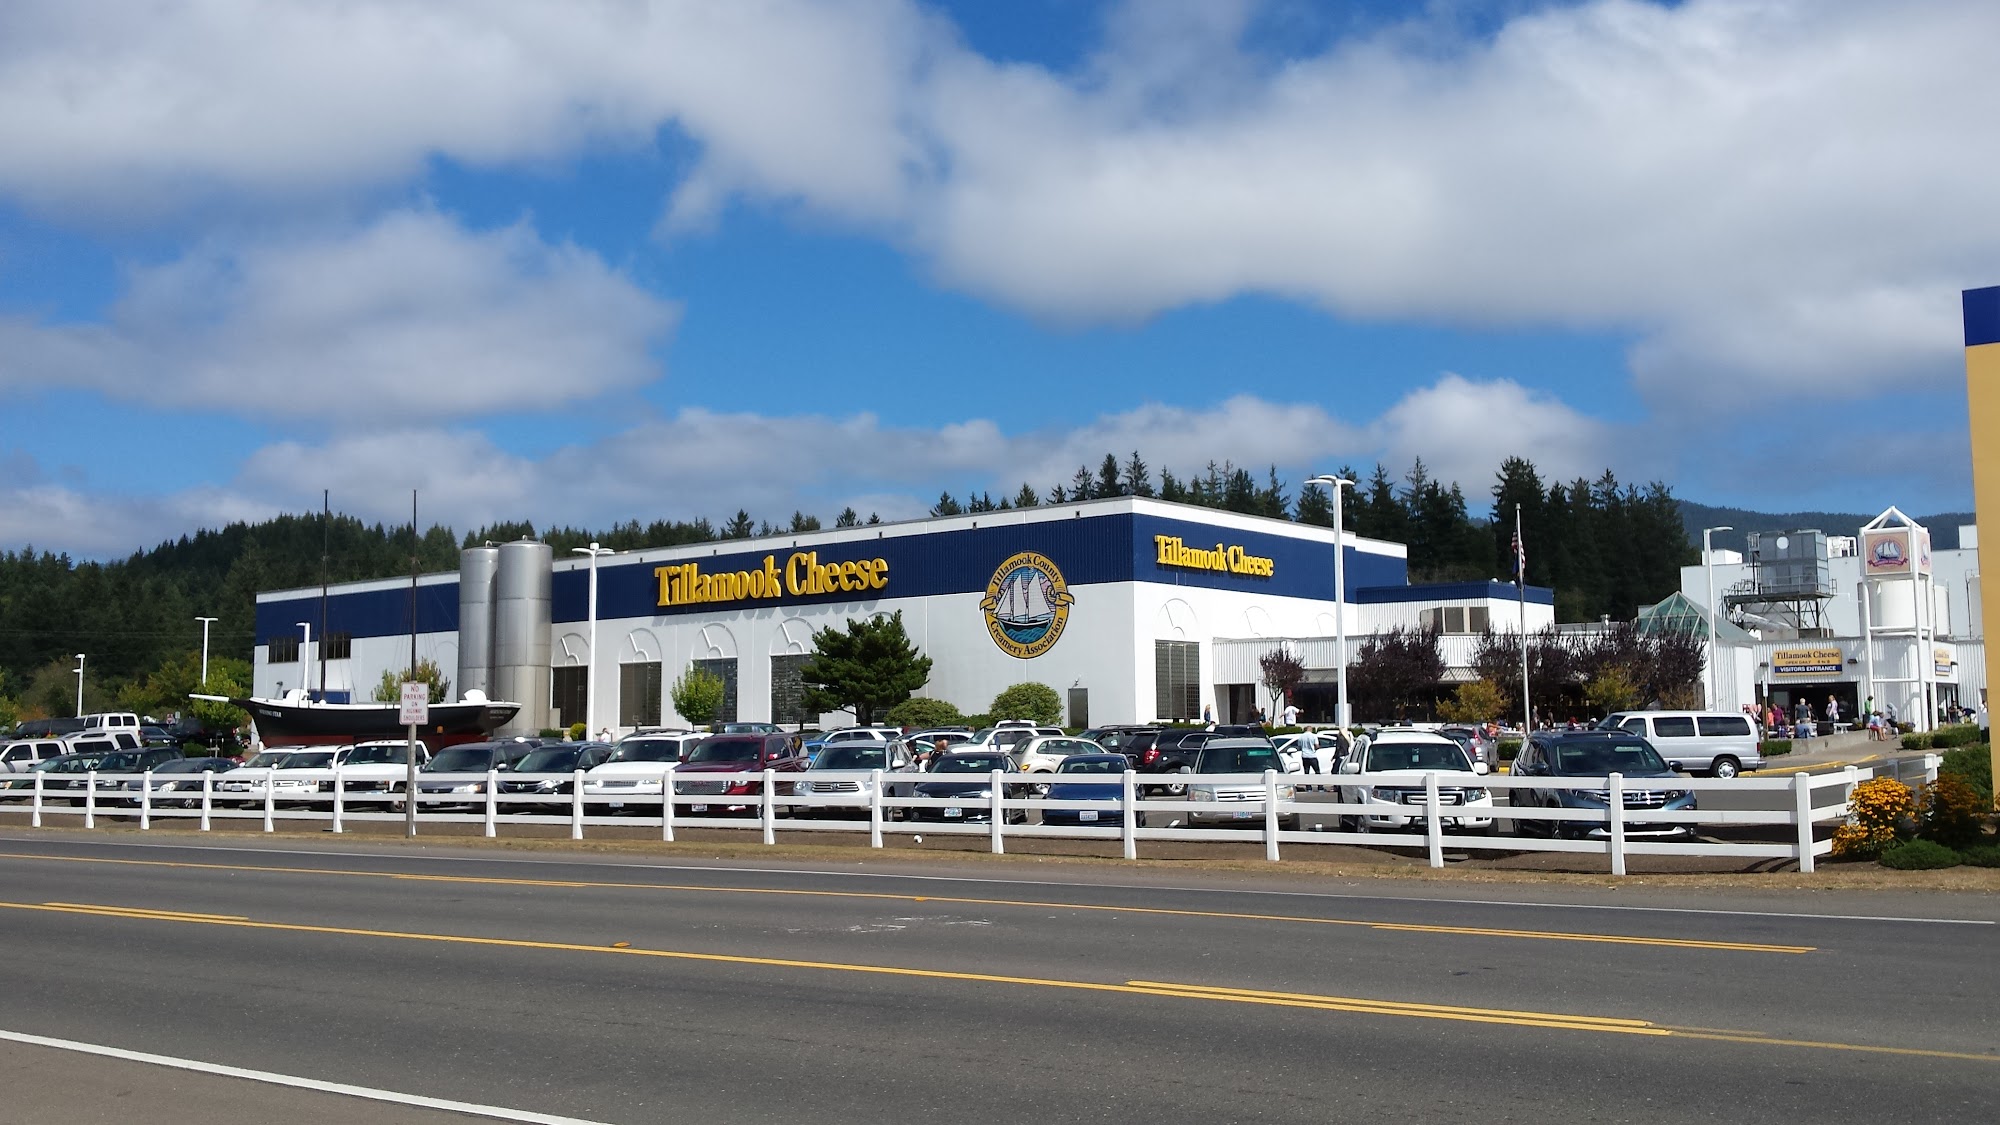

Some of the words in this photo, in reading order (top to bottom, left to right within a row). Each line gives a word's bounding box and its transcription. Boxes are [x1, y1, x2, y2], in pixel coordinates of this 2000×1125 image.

[991, 554, 1032, 588] Tillamook
[1033, 555, 1061, 583] County
[1155, 535, 1227, 571] Tillamook
[1227, 545, 1274, 577] Cheese
[654, 555, 782, 606] Tillamook
[785, 551, 889, 597] Cheese
[990, 620, 1023, 656] Creamery
[1024, 617, 1064, 655] Association
[1776, 651, 1812, 660] Tillamook
[1813, 650, 1840, 658] Cheese
